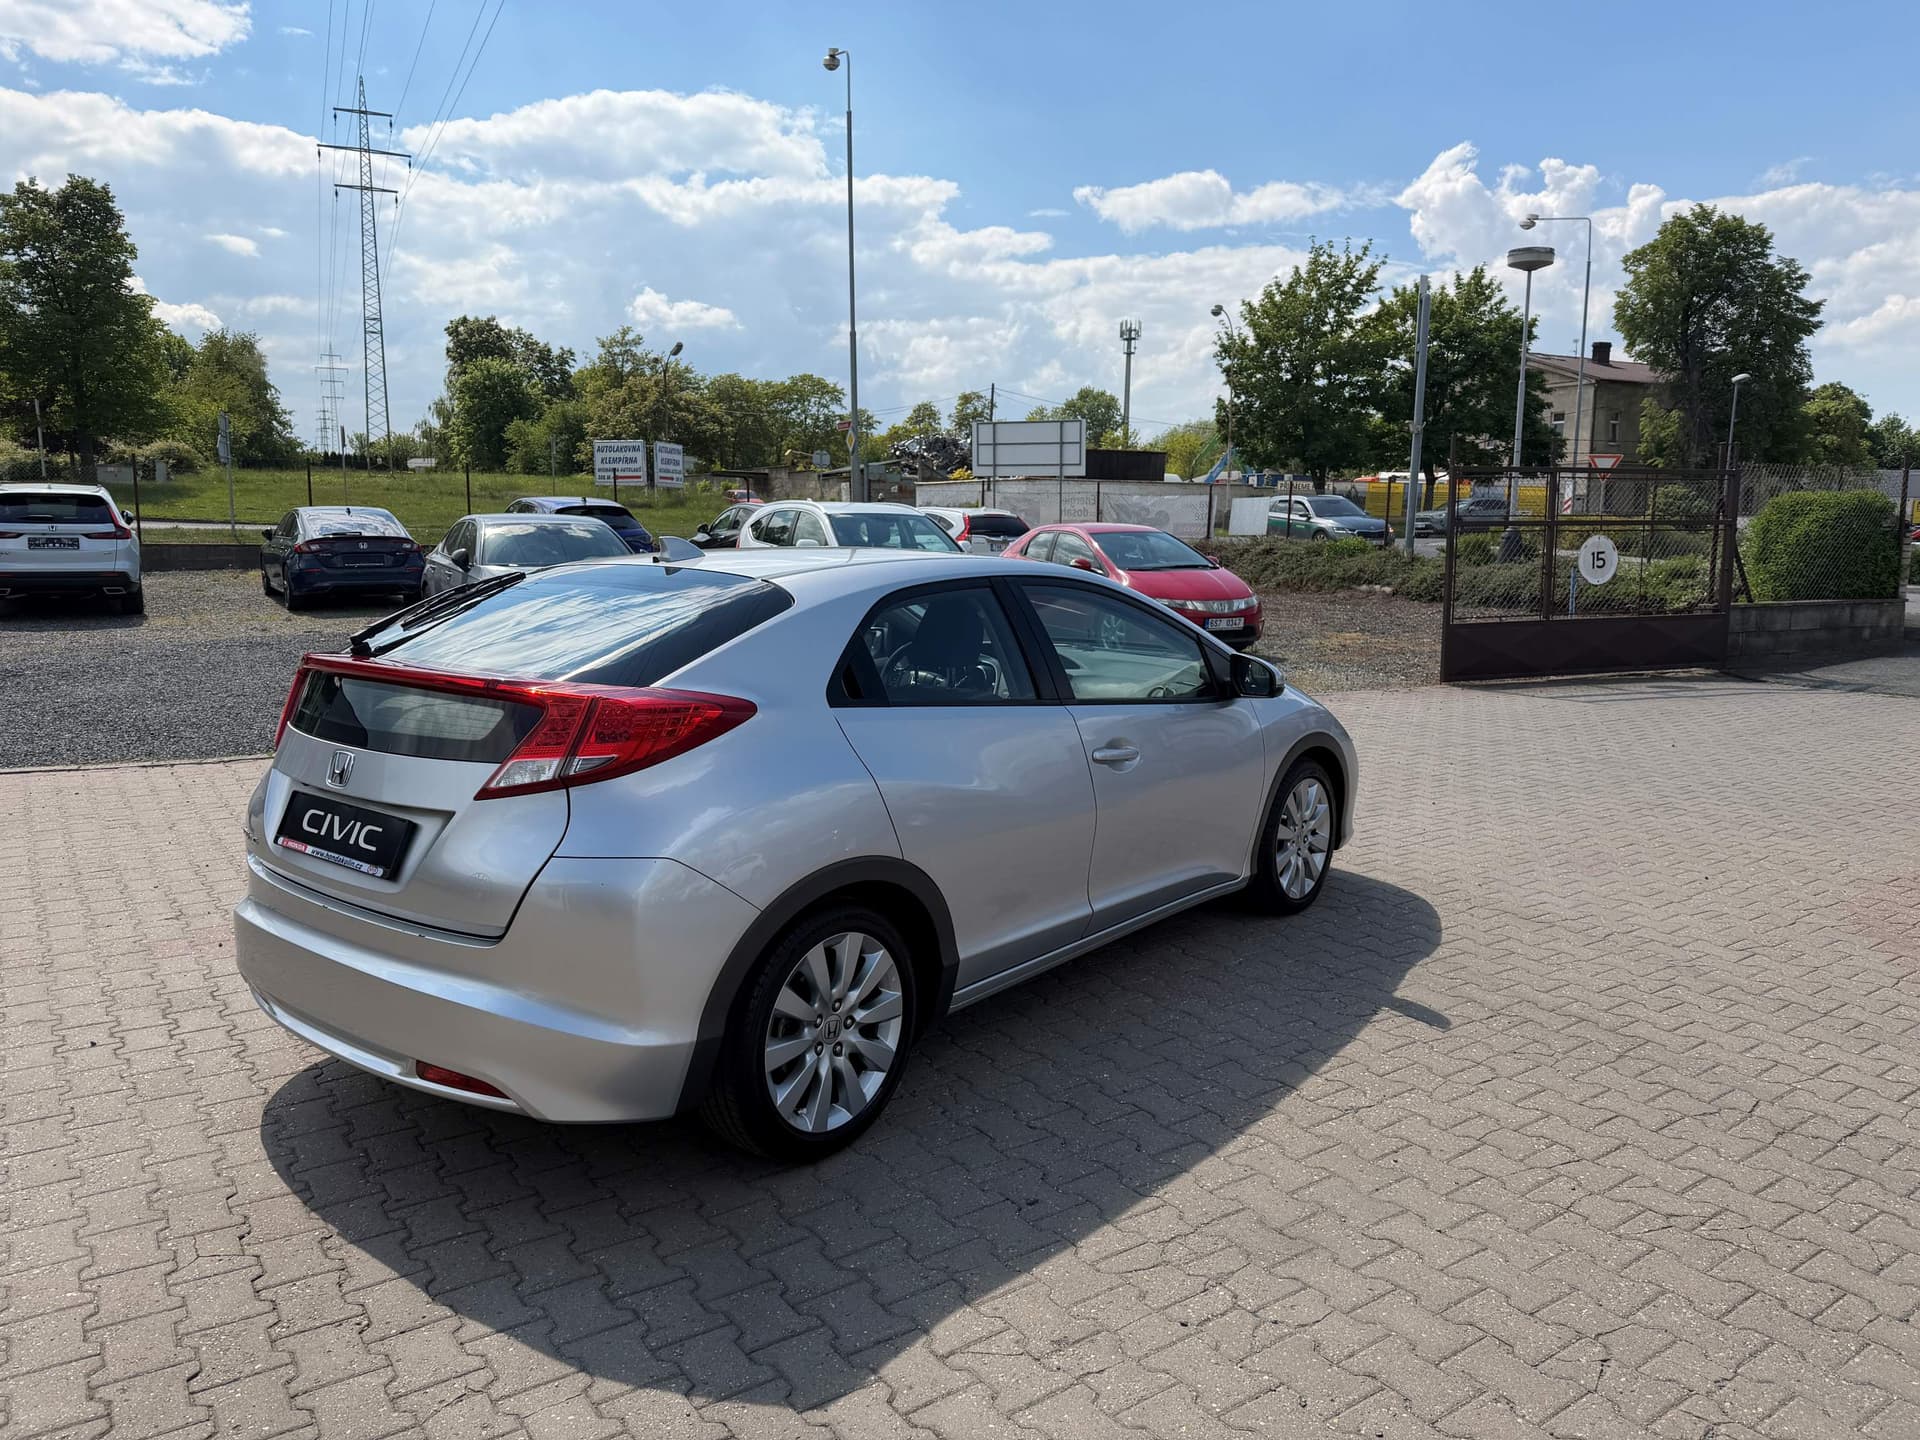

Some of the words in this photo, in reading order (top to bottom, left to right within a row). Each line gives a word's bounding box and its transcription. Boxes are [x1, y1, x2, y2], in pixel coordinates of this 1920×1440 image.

[597, 445, 641, 453] AUTOLAKOVNA
[600, 455, 638, 465] KLEMPÍRNA
[1591, 551, 1606, 569] 15
[302, 809, 383, 851] CIVIC
